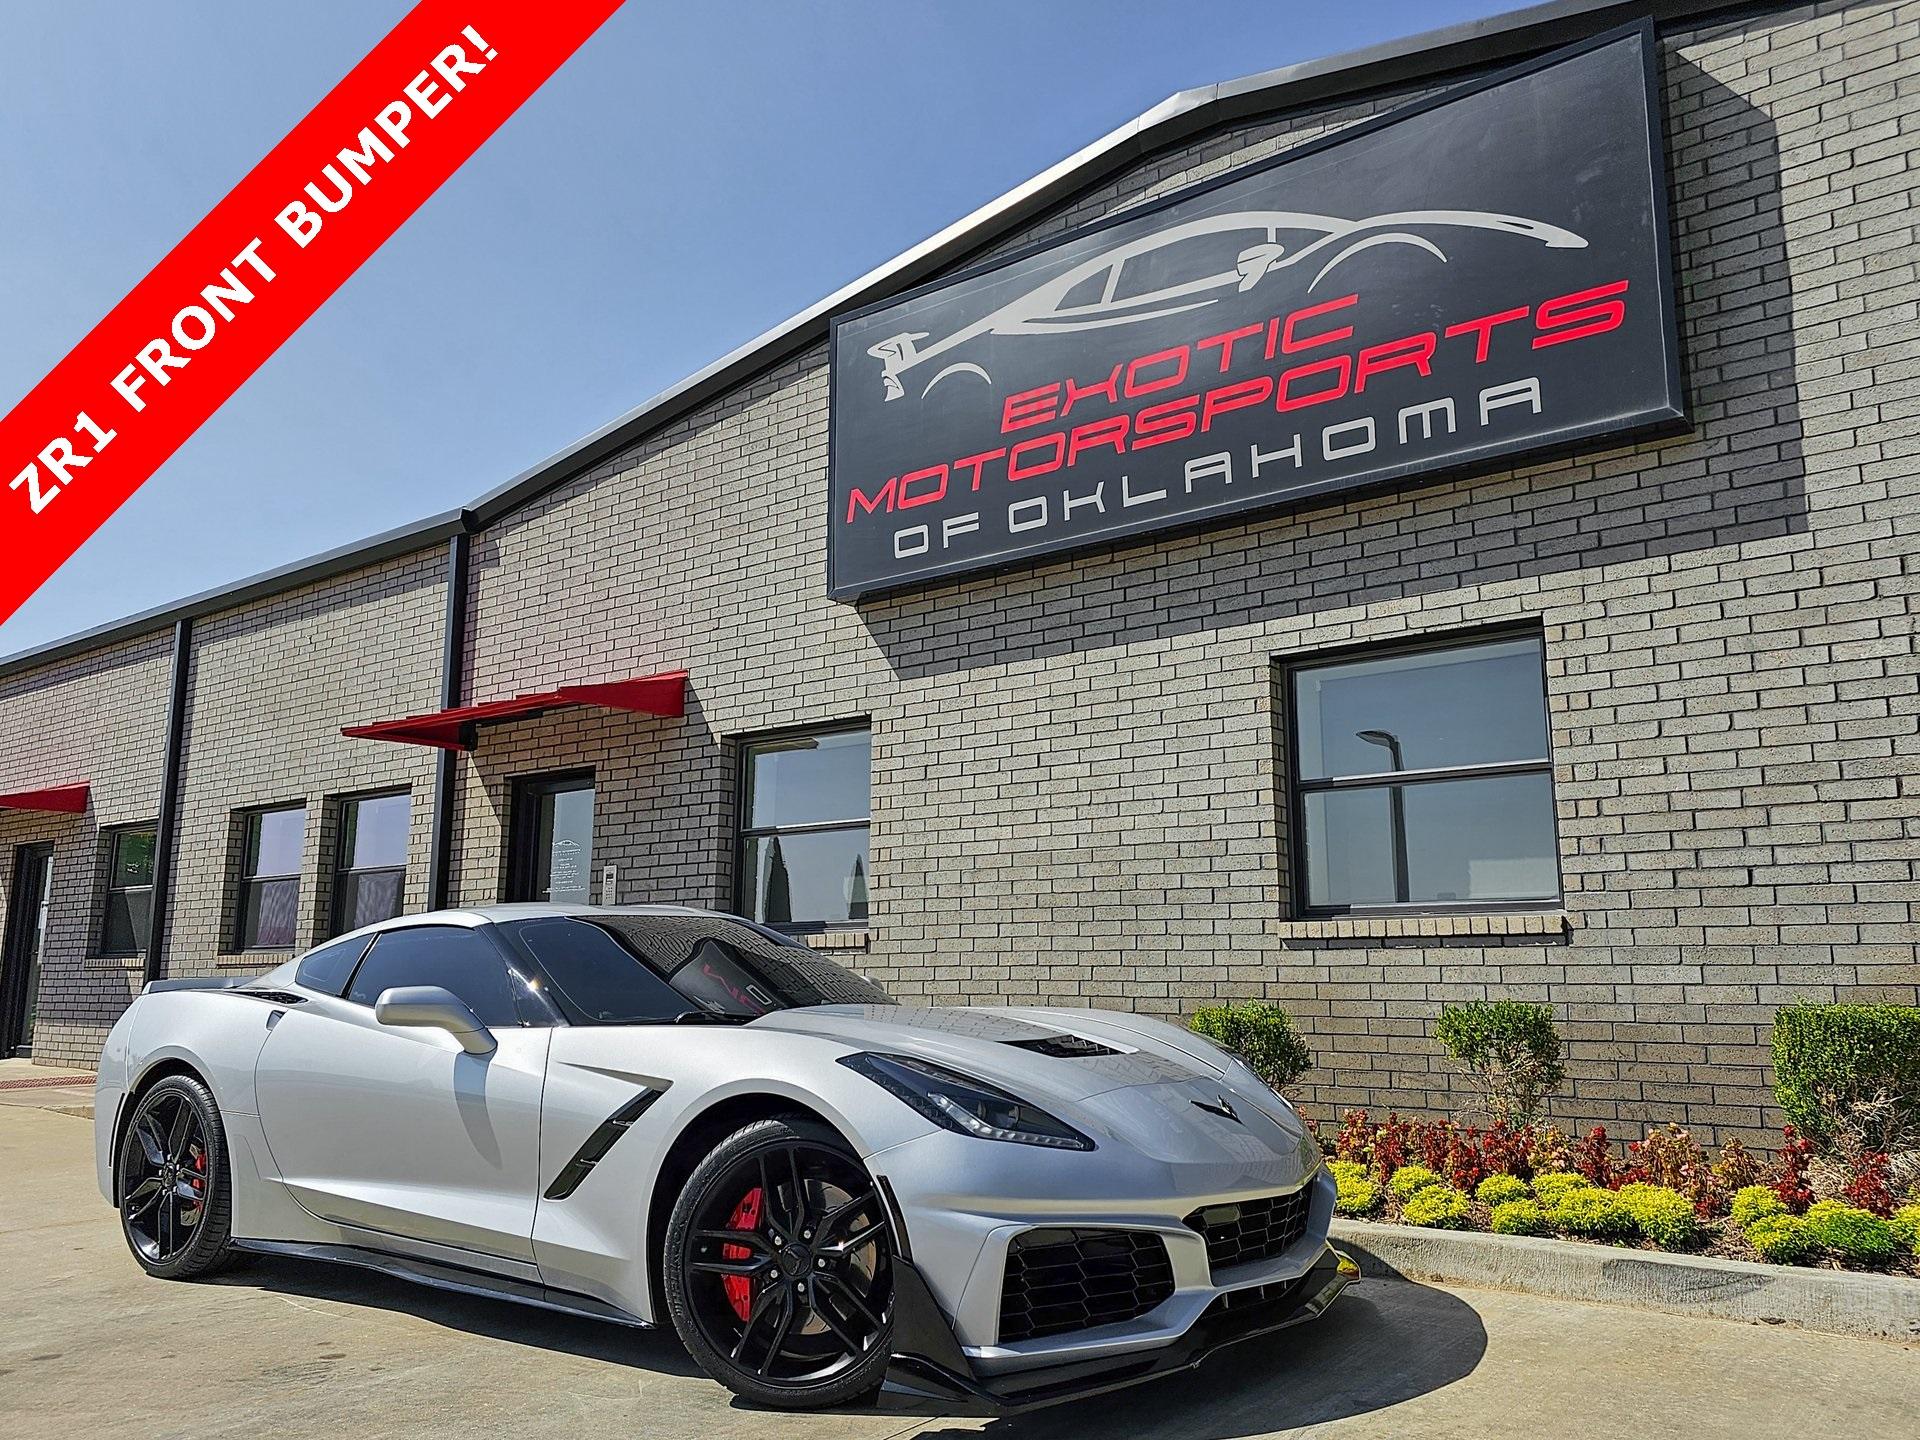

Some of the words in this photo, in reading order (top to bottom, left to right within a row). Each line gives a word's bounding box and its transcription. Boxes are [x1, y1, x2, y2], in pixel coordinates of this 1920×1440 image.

[847, 279, 1629, 523] MOTORSPORTS
[1001, 294, 1359, 433] EXOTIC
[893, 511, 980, 559] OF
[1008, 376, 1542, 534] OKLAHOMA
